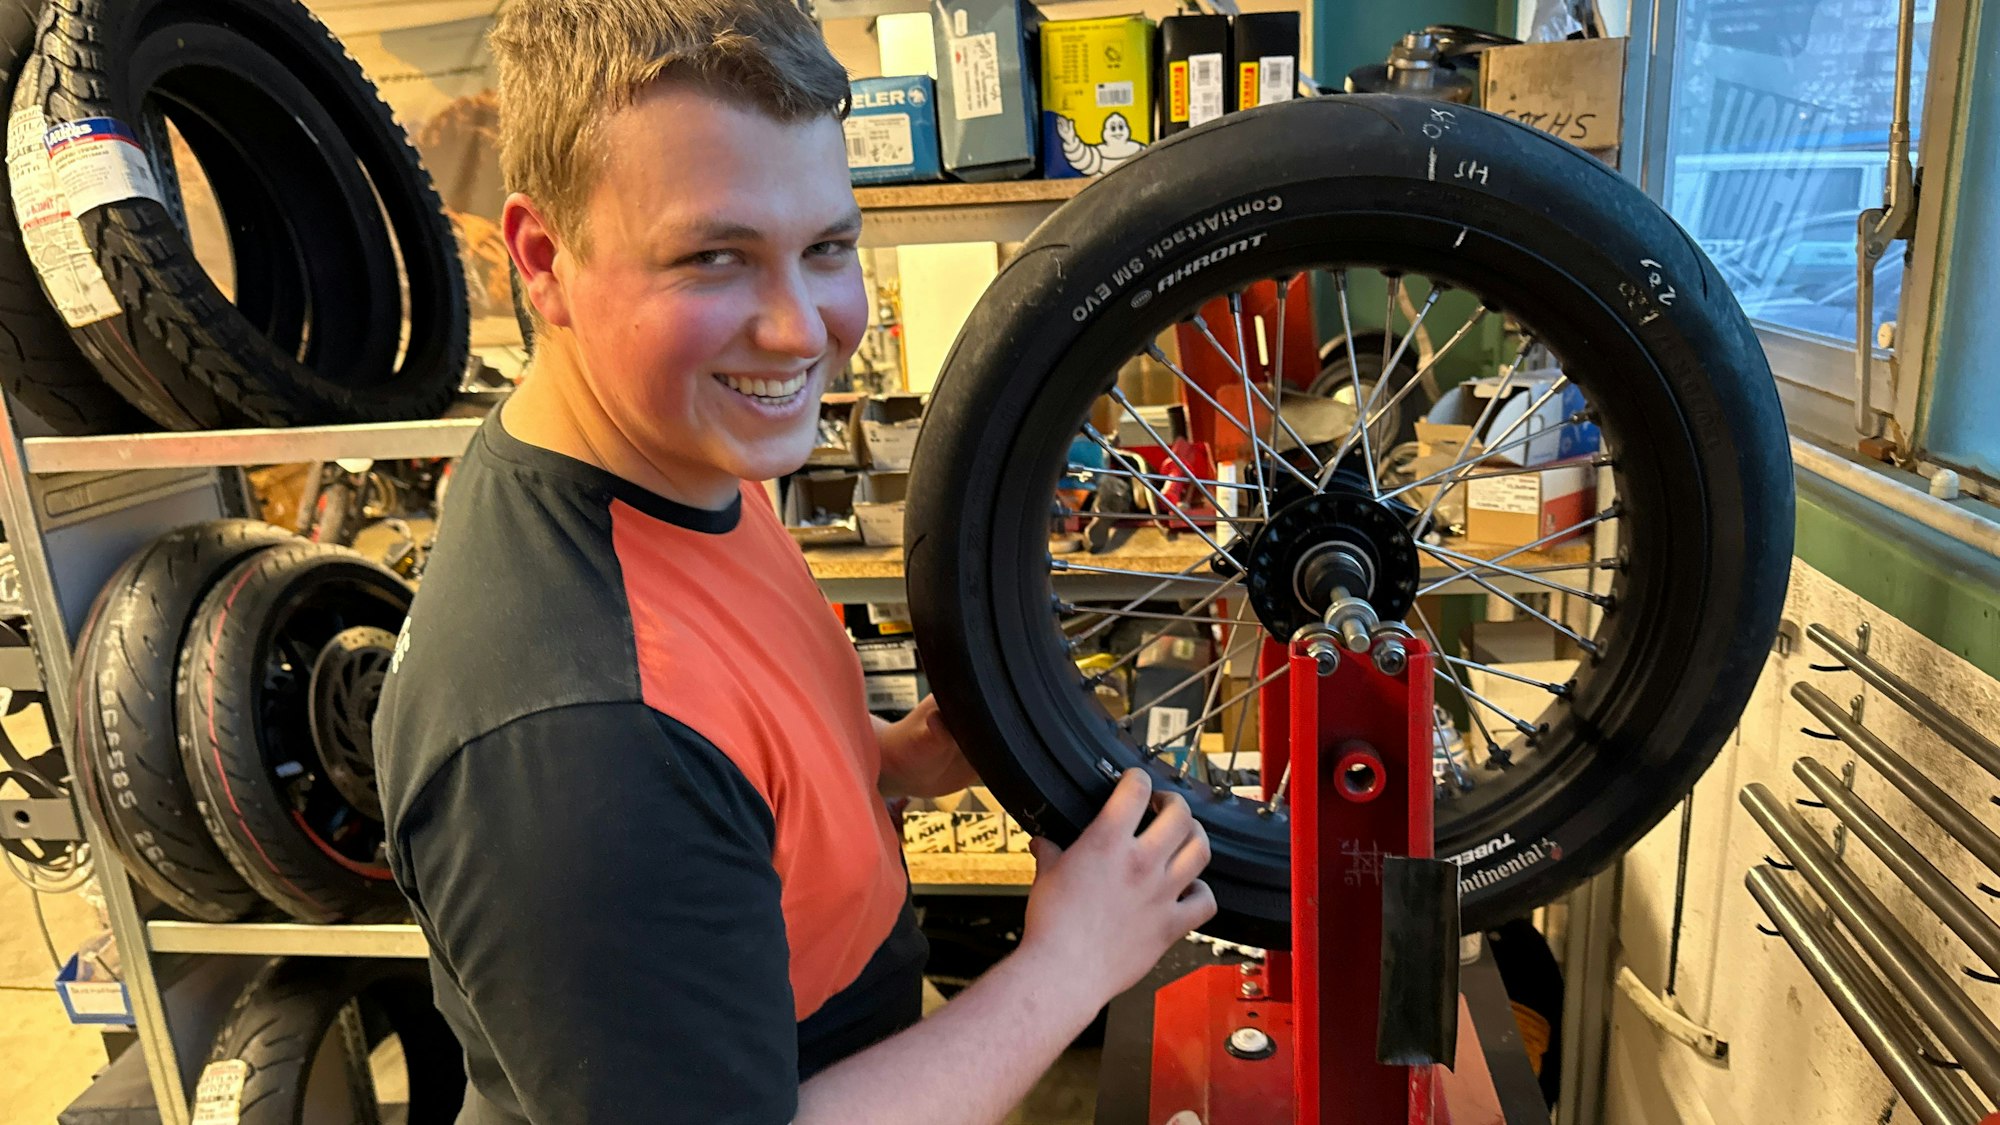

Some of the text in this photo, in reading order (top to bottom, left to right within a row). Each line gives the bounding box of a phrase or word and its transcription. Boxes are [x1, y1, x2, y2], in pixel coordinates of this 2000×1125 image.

[1147, 194, 1284, 261] ContiAttack
[1112, 256, 1146, 288] SM
[1071, 282, 1113, 322] EVO
[1460, 843, 1546, 895] ntinental
